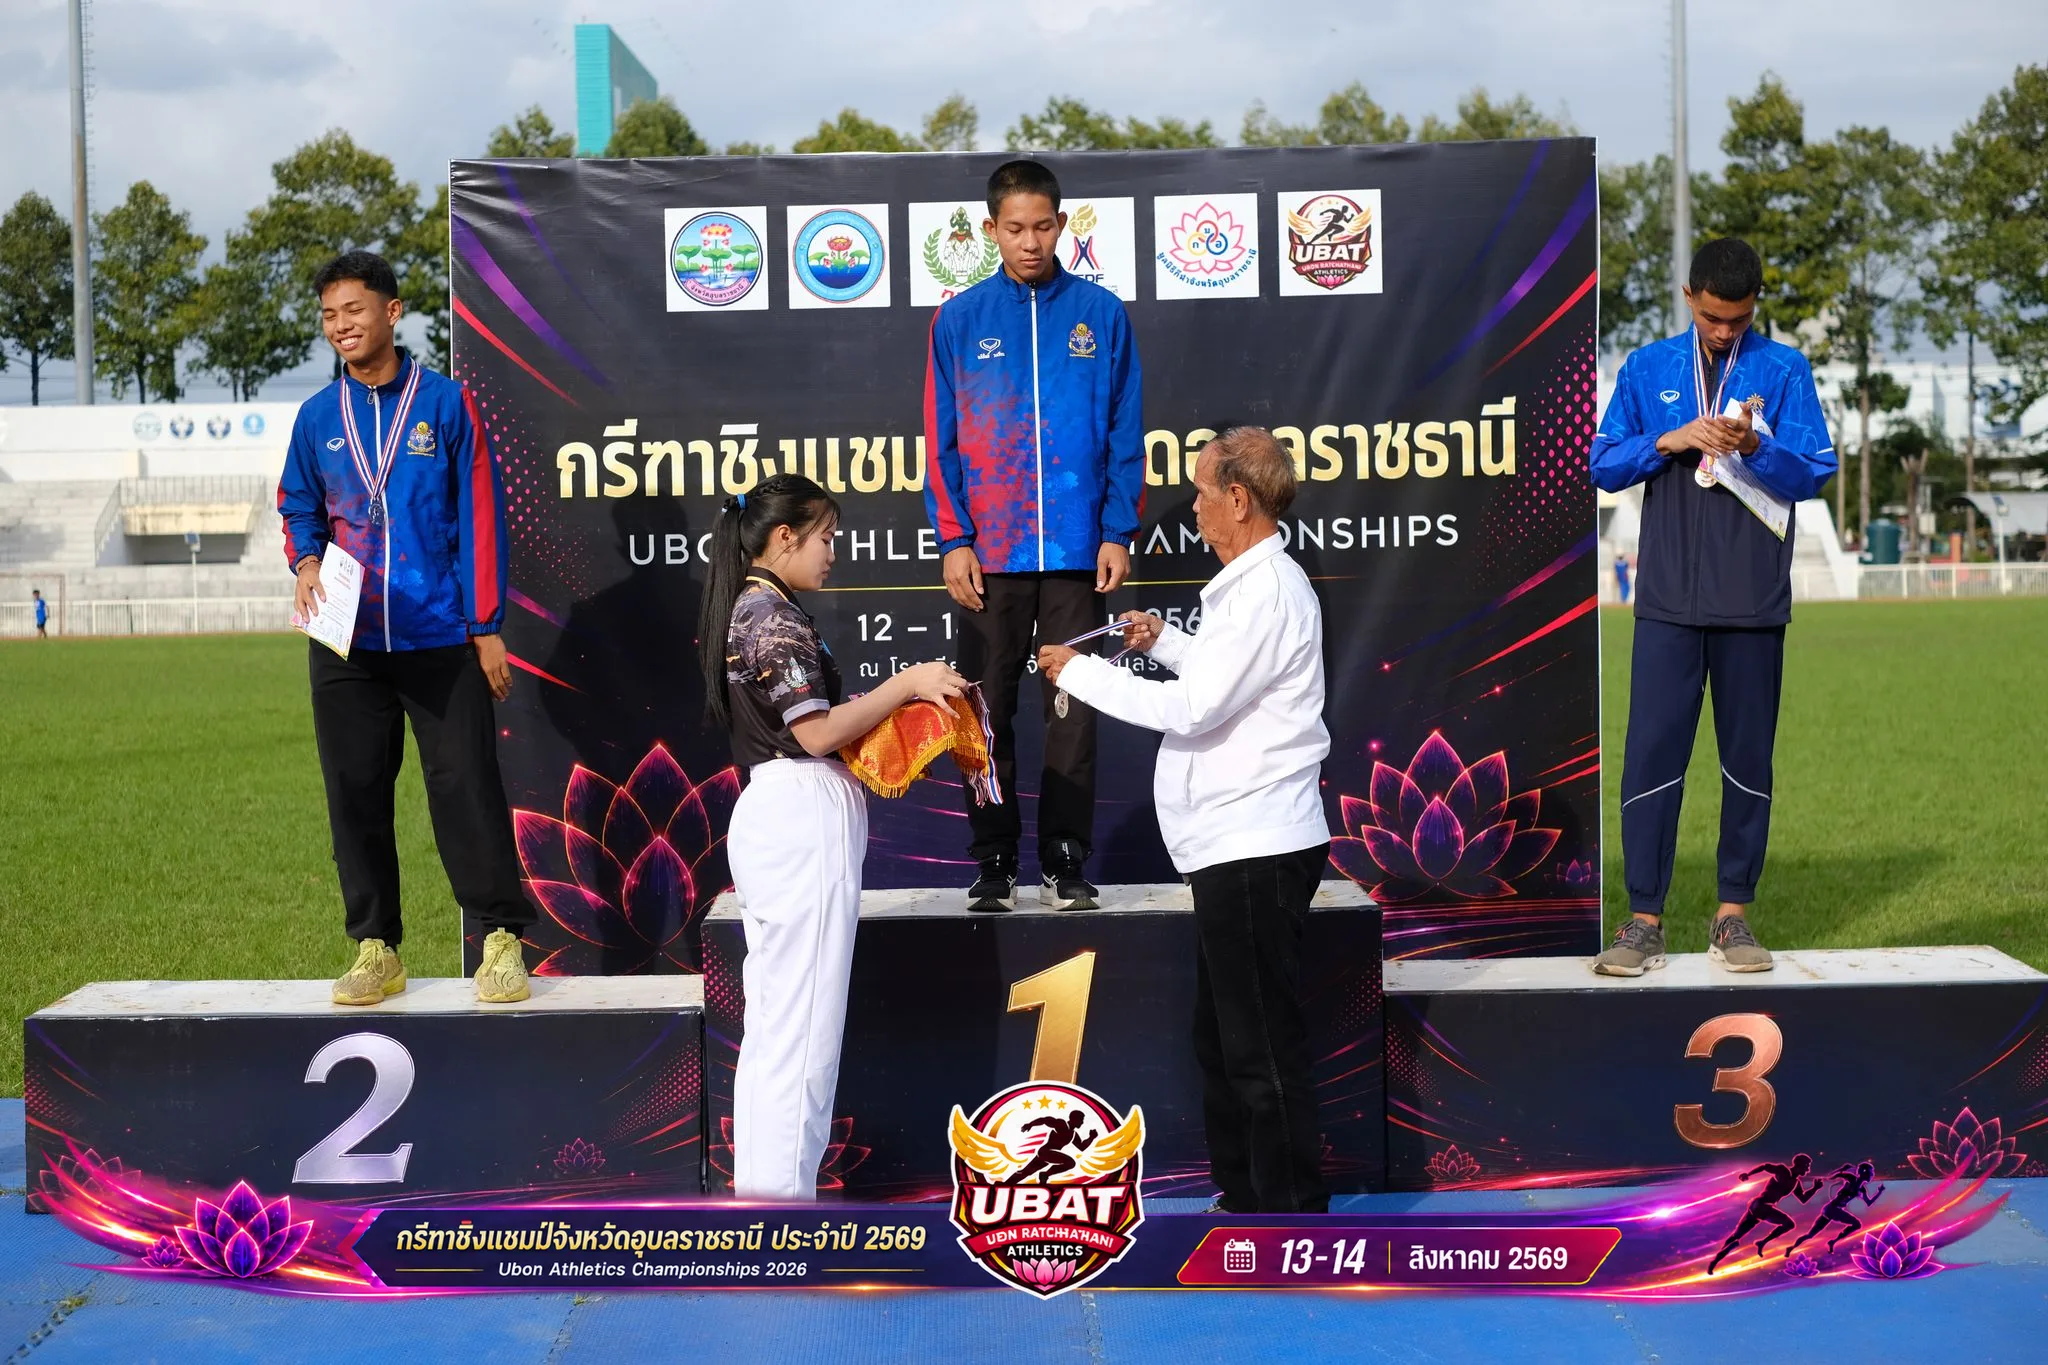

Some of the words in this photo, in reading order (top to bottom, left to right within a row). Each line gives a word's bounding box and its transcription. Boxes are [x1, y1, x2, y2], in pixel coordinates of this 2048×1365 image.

[1295, 242, 1366, 263] UBAT
[857, 613, 893, 642] 12
[859, 662, 879, 678] ณ
[1007, 951, 1097, 1085] 1
[292, 1031, 416, 1184] 2
[1674, 1012, 1783, 1149] 3
